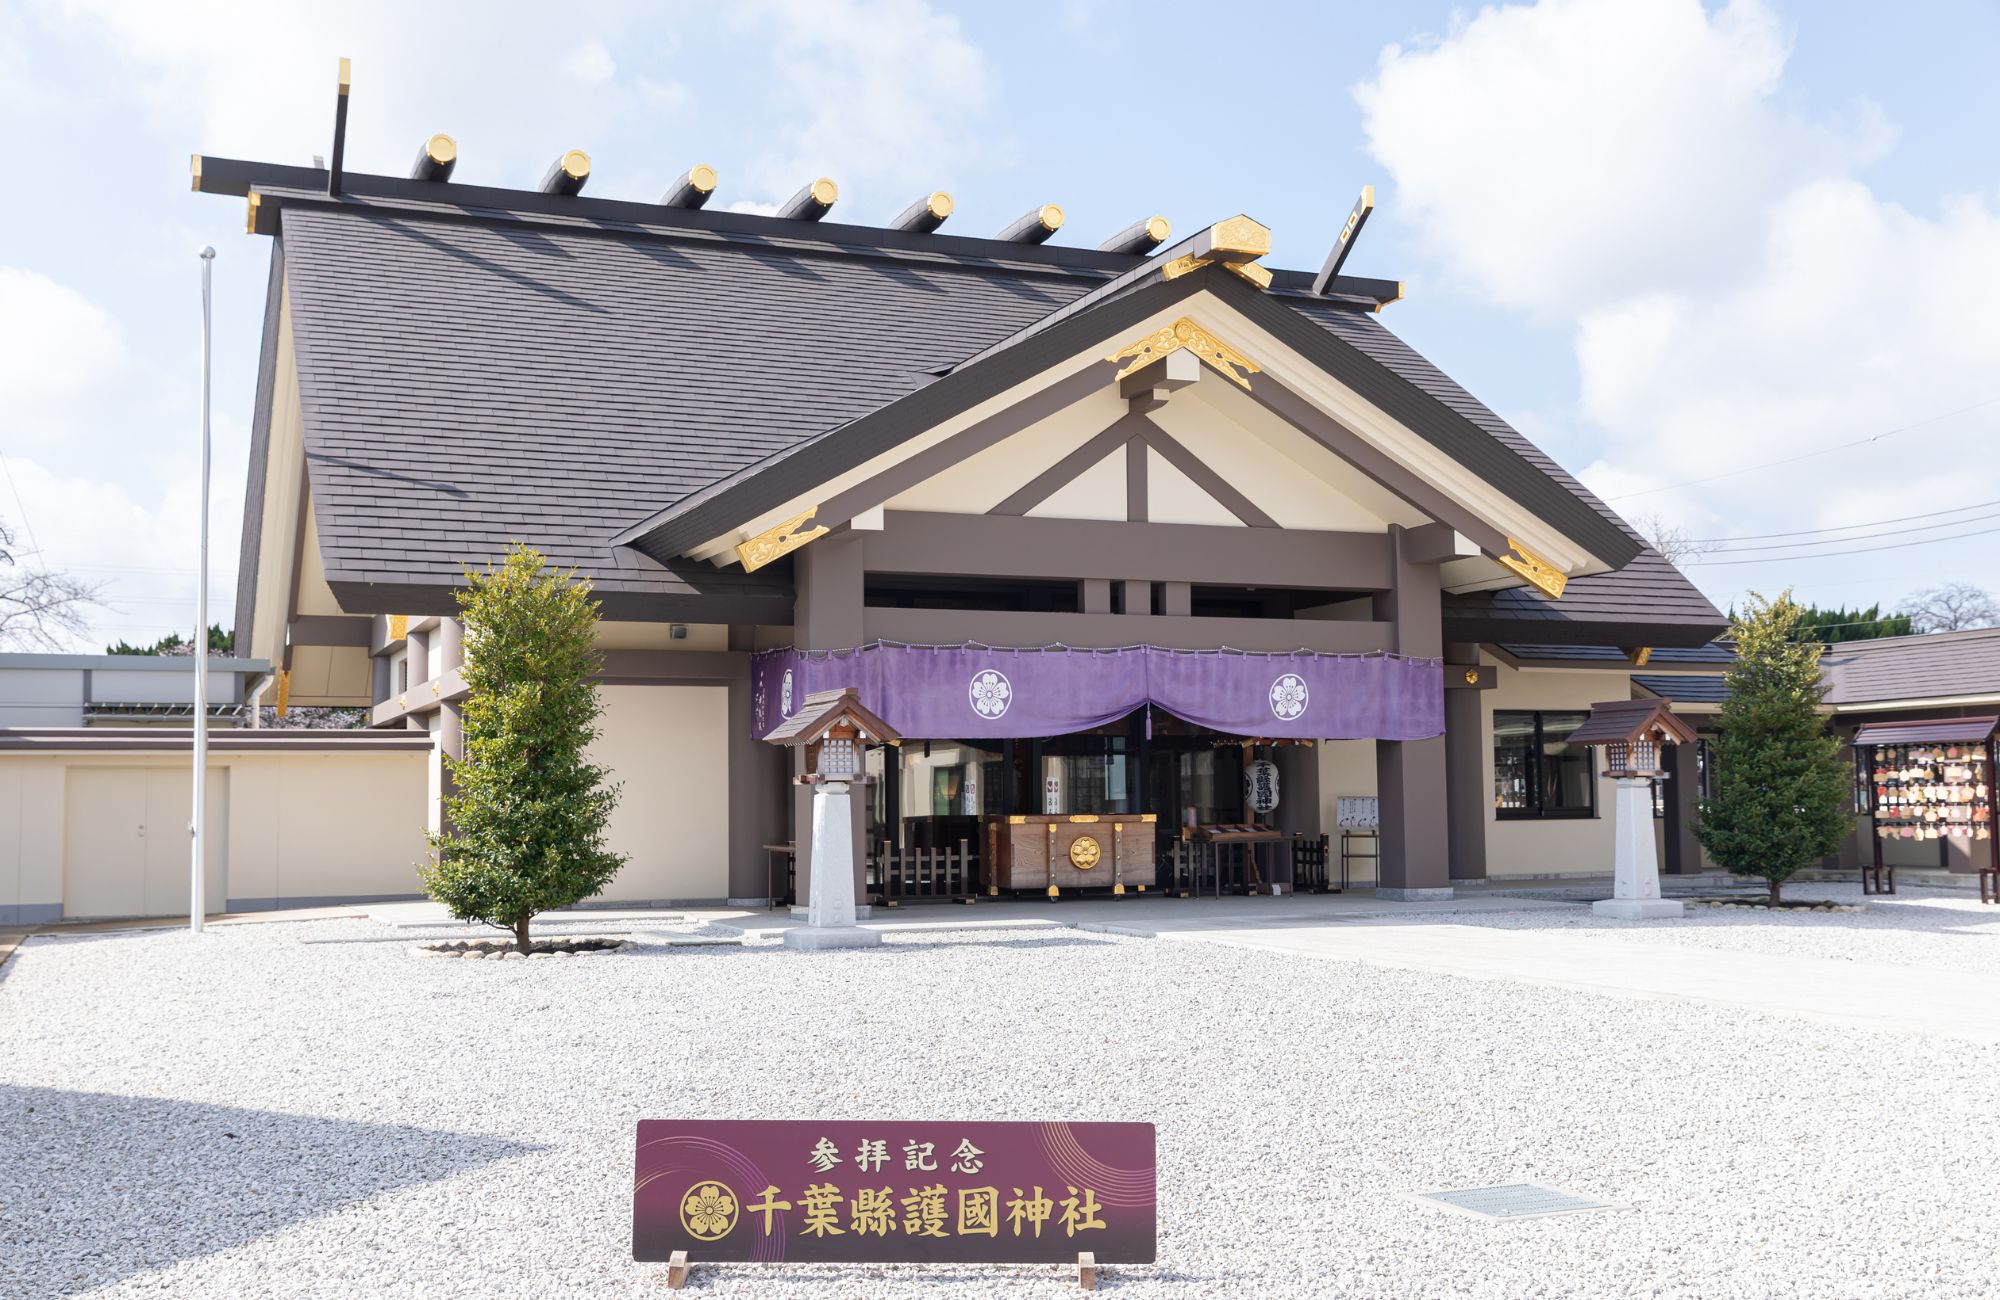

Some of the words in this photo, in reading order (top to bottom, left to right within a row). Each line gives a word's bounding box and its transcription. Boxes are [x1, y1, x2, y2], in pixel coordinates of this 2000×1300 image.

[807, 1136, 985, 1174] 参拝記念
[745, 1182, 1107, 1239] 千葉縣護國神社
